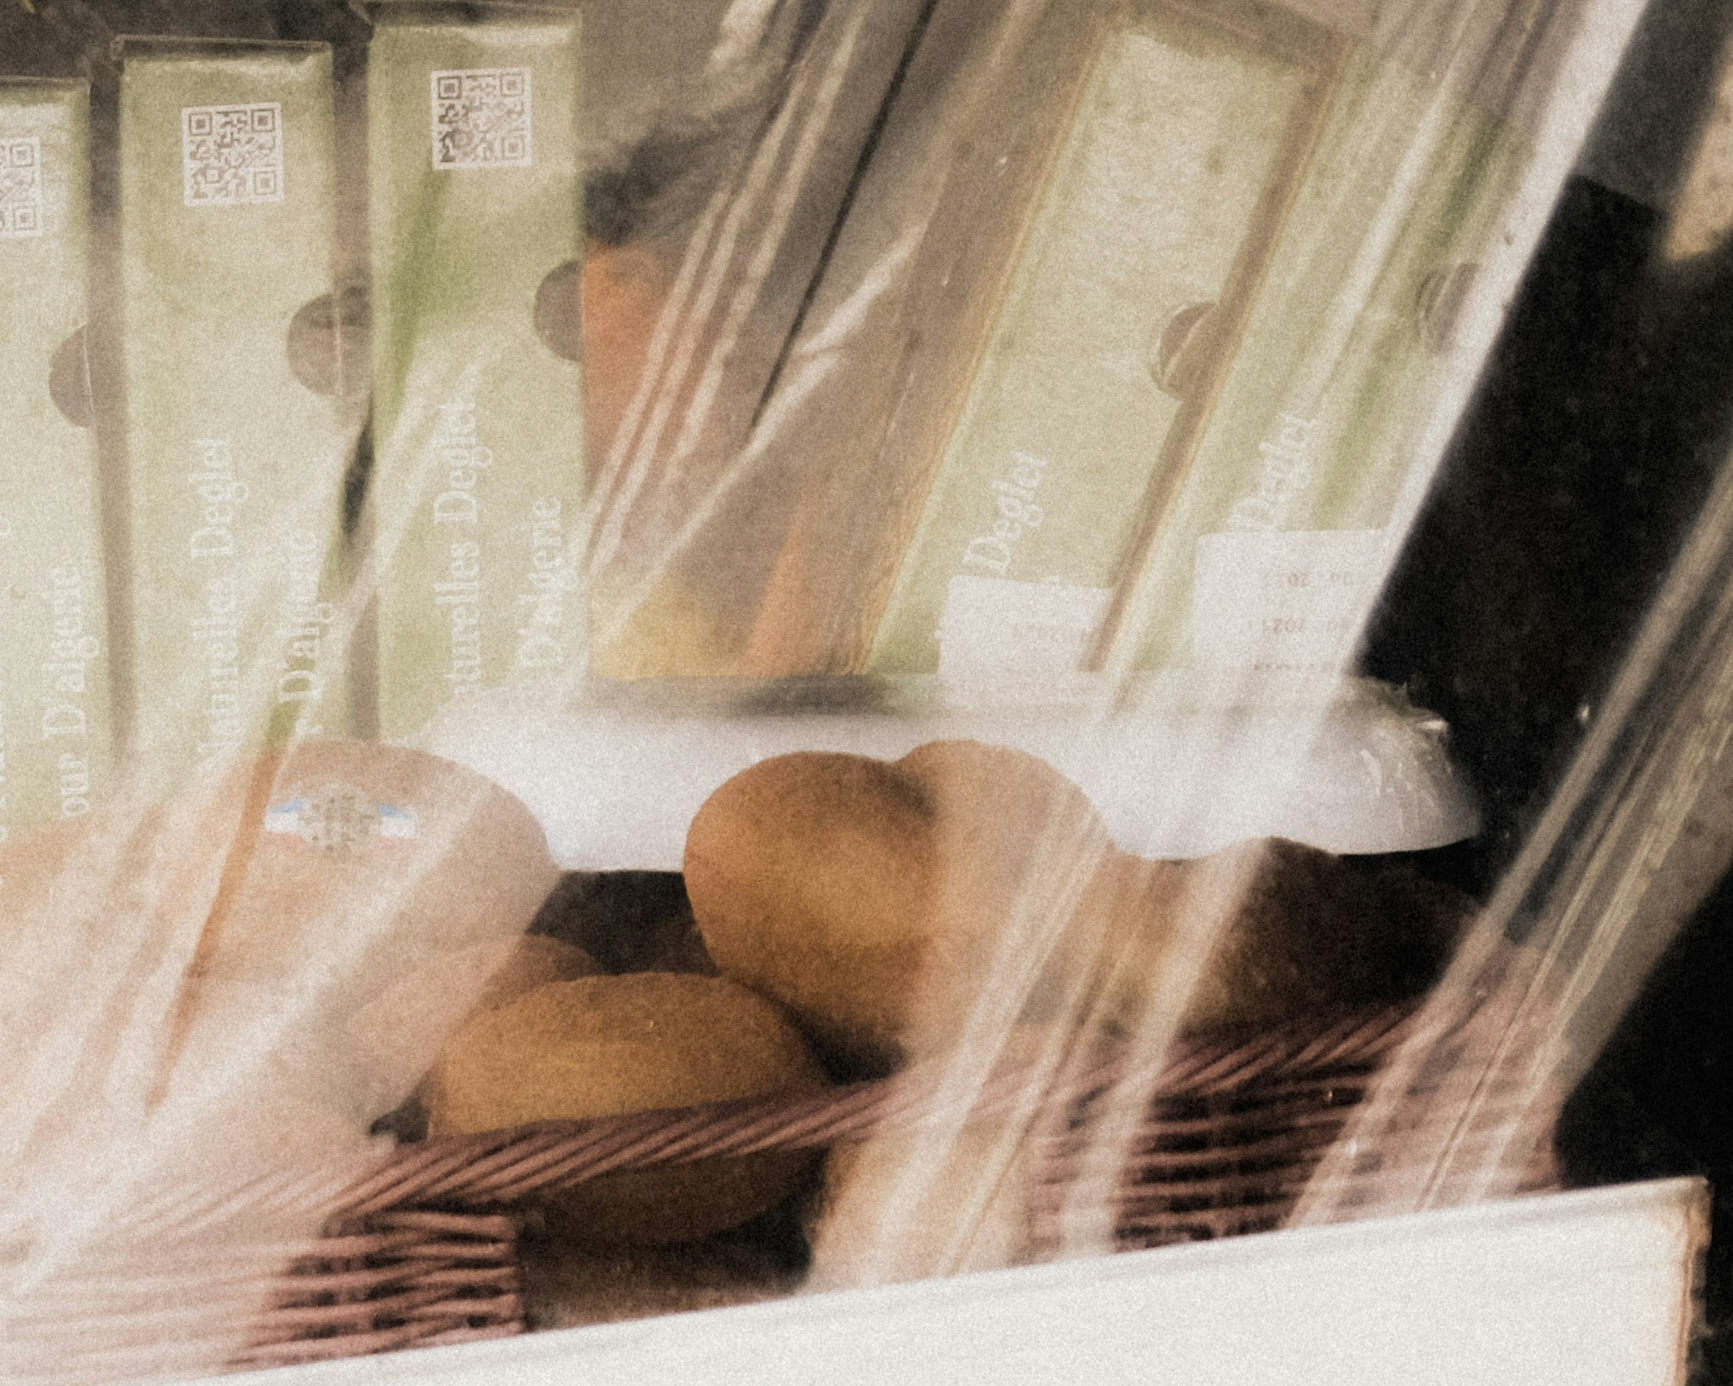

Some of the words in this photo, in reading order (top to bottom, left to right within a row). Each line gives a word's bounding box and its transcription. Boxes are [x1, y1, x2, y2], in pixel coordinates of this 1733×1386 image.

[187, 433, 249, 560] Deglet
[433, 396, 495, 525] Deglet
[962, 449, 1050, 577] Deglet
[39, 565, 100, 739] D'algerie
[53, 751, 92, 821] our
